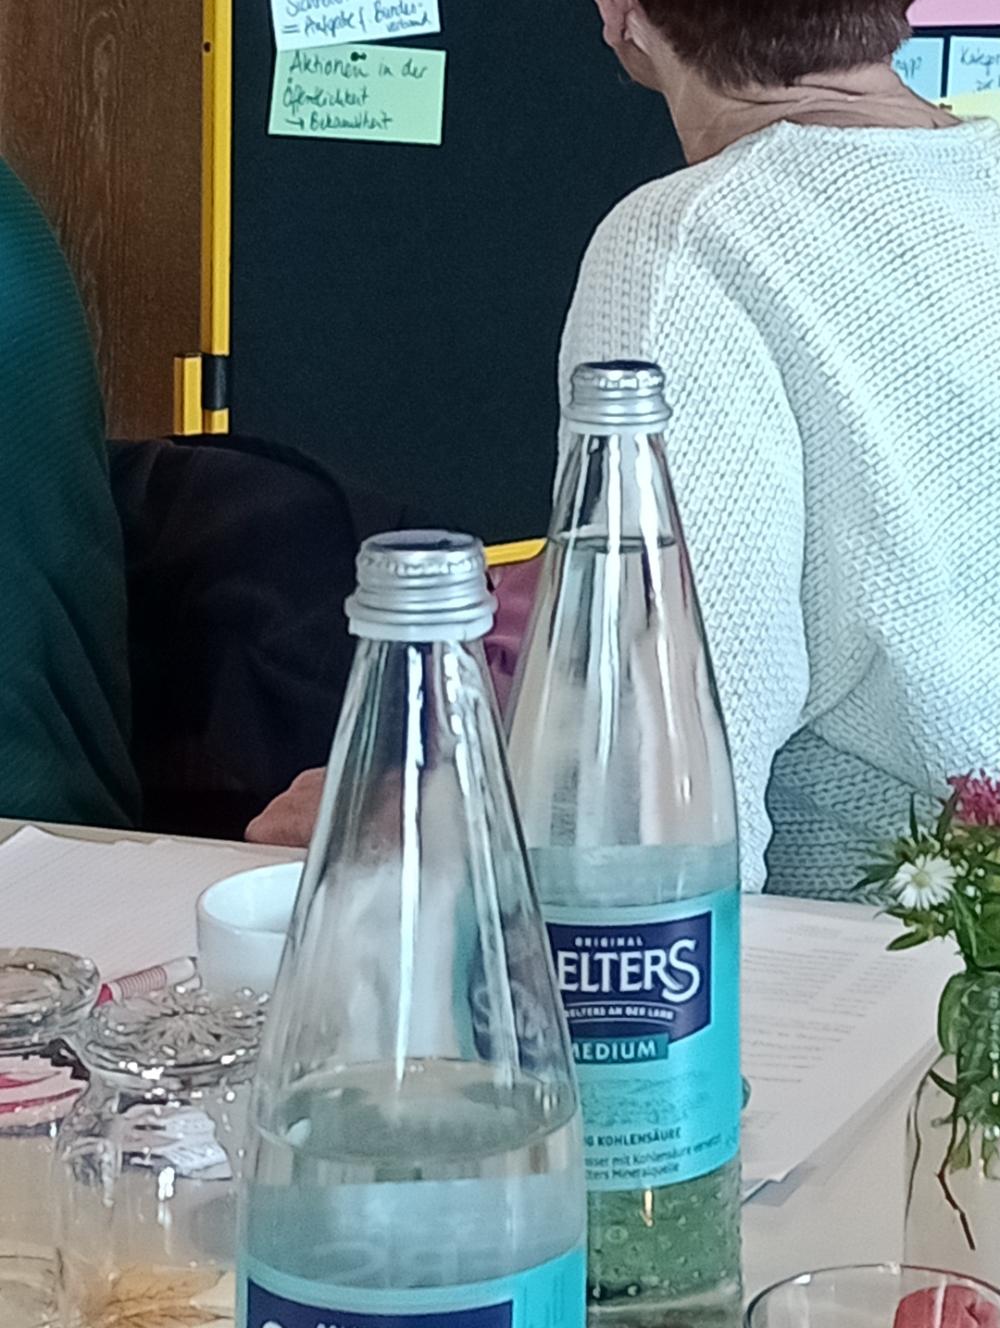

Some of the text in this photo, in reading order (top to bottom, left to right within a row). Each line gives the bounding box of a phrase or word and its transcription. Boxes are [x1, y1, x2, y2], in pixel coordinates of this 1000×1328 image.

[289, 49, 429, 79] Aktionen in der
[574, 935, 644, 948] ORIGINAL
[557, 938, 701, 1003] ELTERS
[598, 1127, 682, 1145] KOHLENSÄURE
